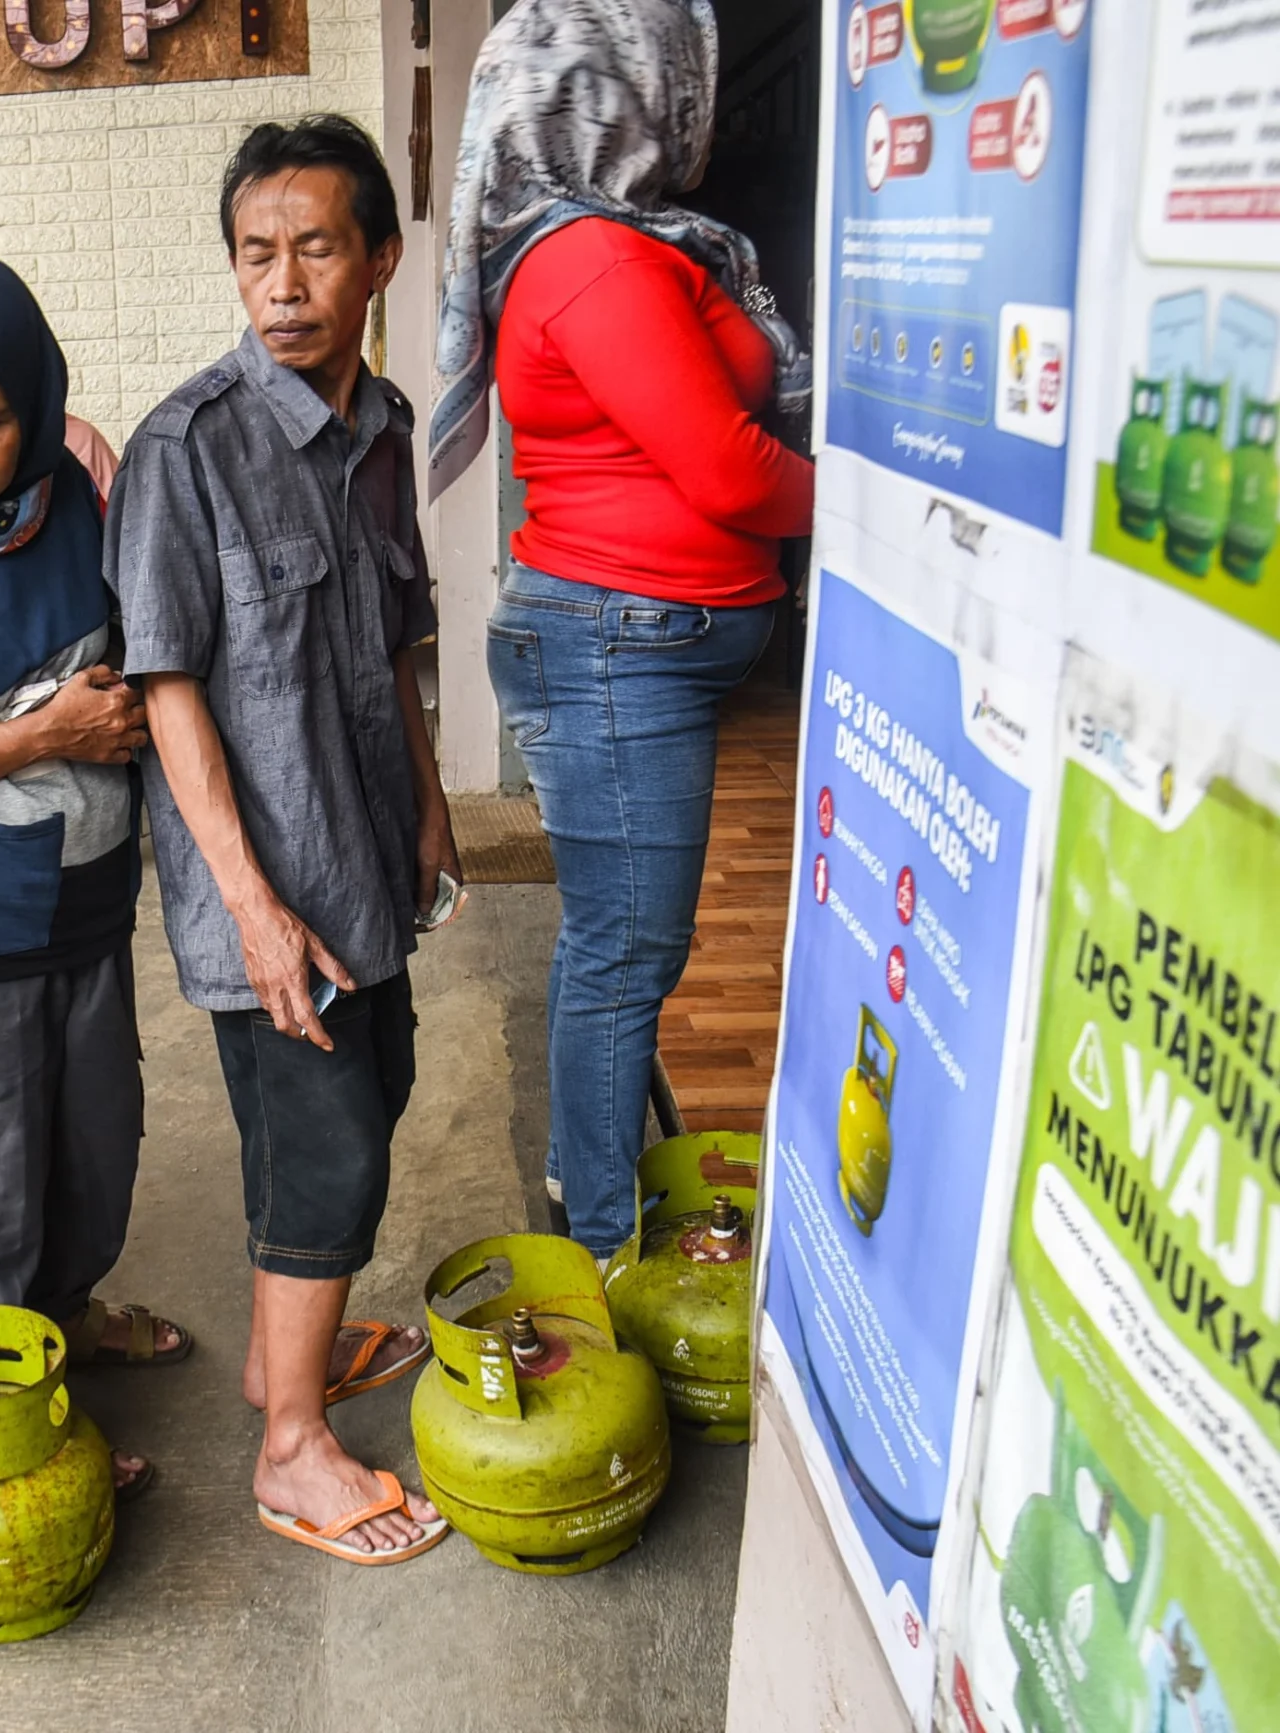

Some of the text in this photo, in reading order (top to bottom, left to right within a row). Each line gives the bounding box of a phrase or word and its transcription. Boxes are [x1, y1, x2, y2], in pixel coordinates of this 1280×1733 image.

[823, 669, 854, 719] LPG
[852, 691, 866, 730] 3
[864, 701, 891, 749] KG
[890, 720, 946, 806] HANYA
[944, 772, 1001, 864] BOLEH
[834, 722, 932, 839] DIGUNAKAN
[1072, 929, 1133, 1022] LPG
